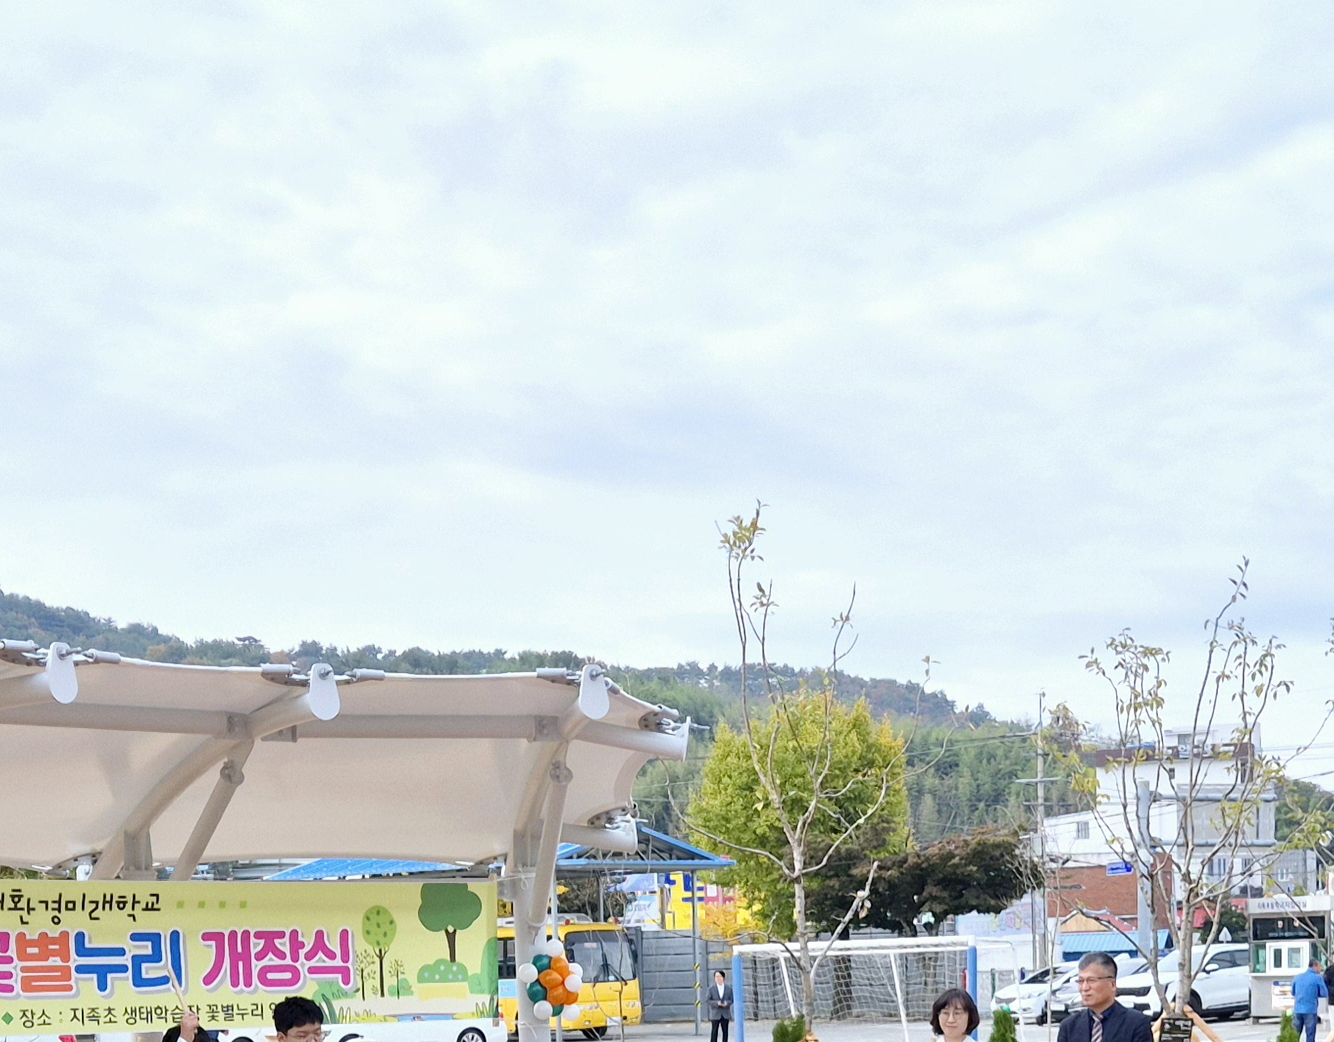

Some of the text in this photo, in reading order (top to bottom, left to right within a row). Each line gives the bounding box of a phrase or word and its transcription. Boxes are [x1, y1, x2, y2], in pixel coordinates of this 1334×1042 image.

[200, 928, 353, 990] 개장식
[19, 1008, 53, 1029] 장소
[70, 1006, 118, 1027] 지족초
[205, 1002, 264, 1023] 꽃별누리
